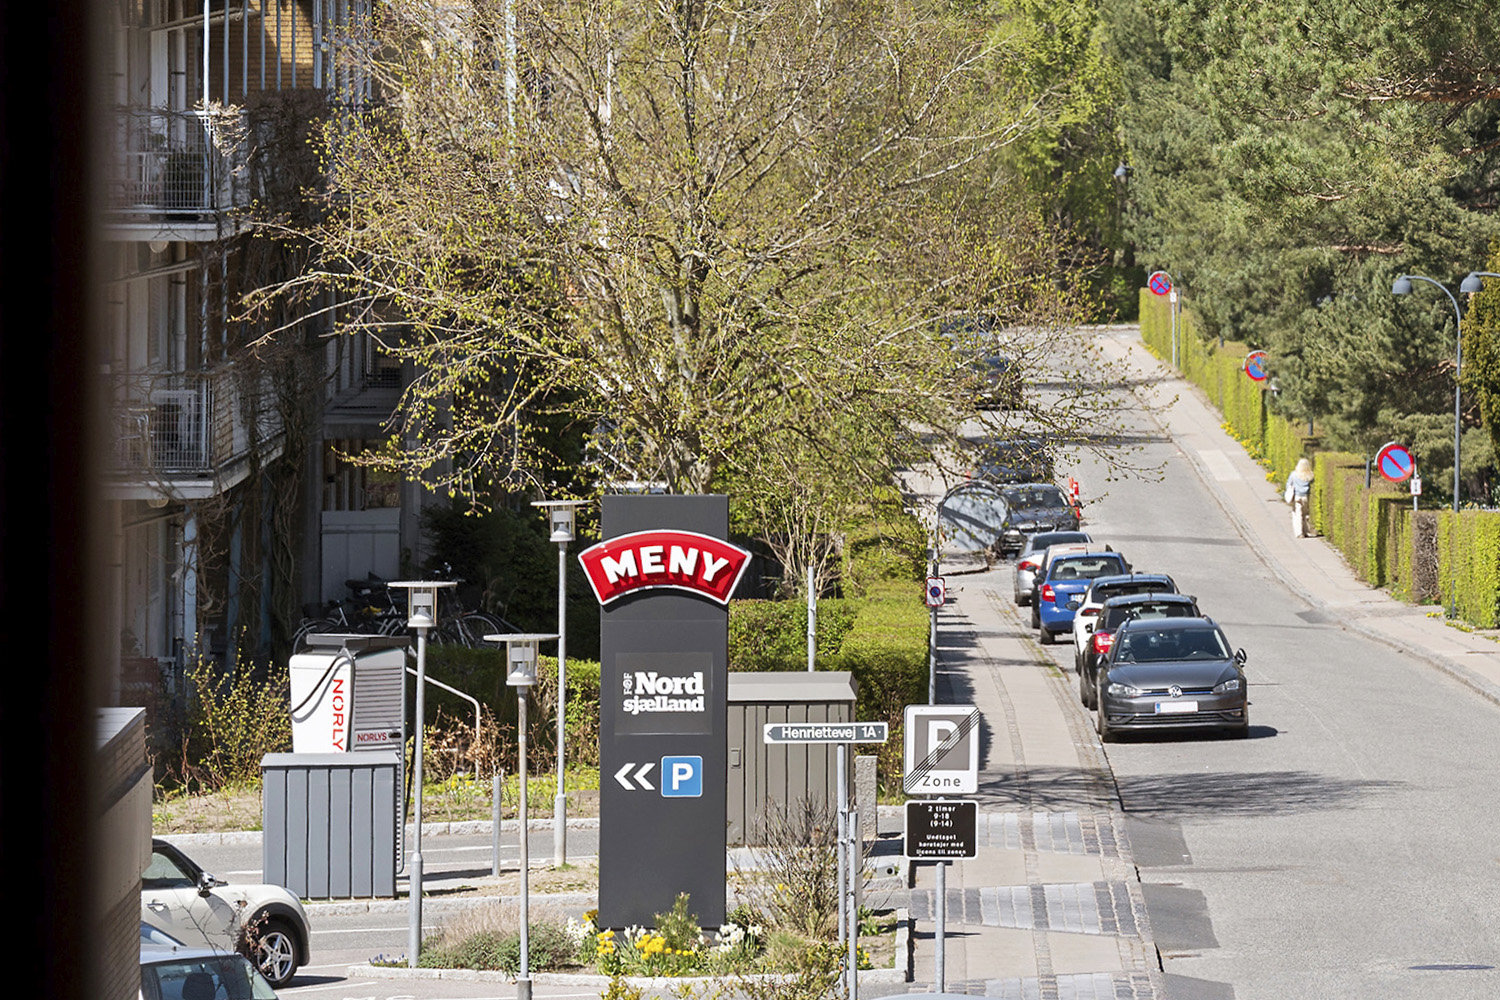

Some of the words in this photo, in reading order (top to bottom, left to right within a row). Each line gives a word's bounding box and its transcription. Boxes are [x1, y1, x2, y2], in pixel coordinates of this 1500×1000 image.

[600, 545, 730, 584] MENY
[635, 671, 704, 695] Nord
[332, 679, 344, 753] NORLY
[623, 695, 705, 715] sjælland
[357, 732, 387, 742] NORLYS
[781, 726, 856, 740] Henriettevej
[861, 726, 877, 738] 1A
[928, 720, 961, 766] P
[672, 762, 694, 790] P
[922, 775, 961, 787] Zone
